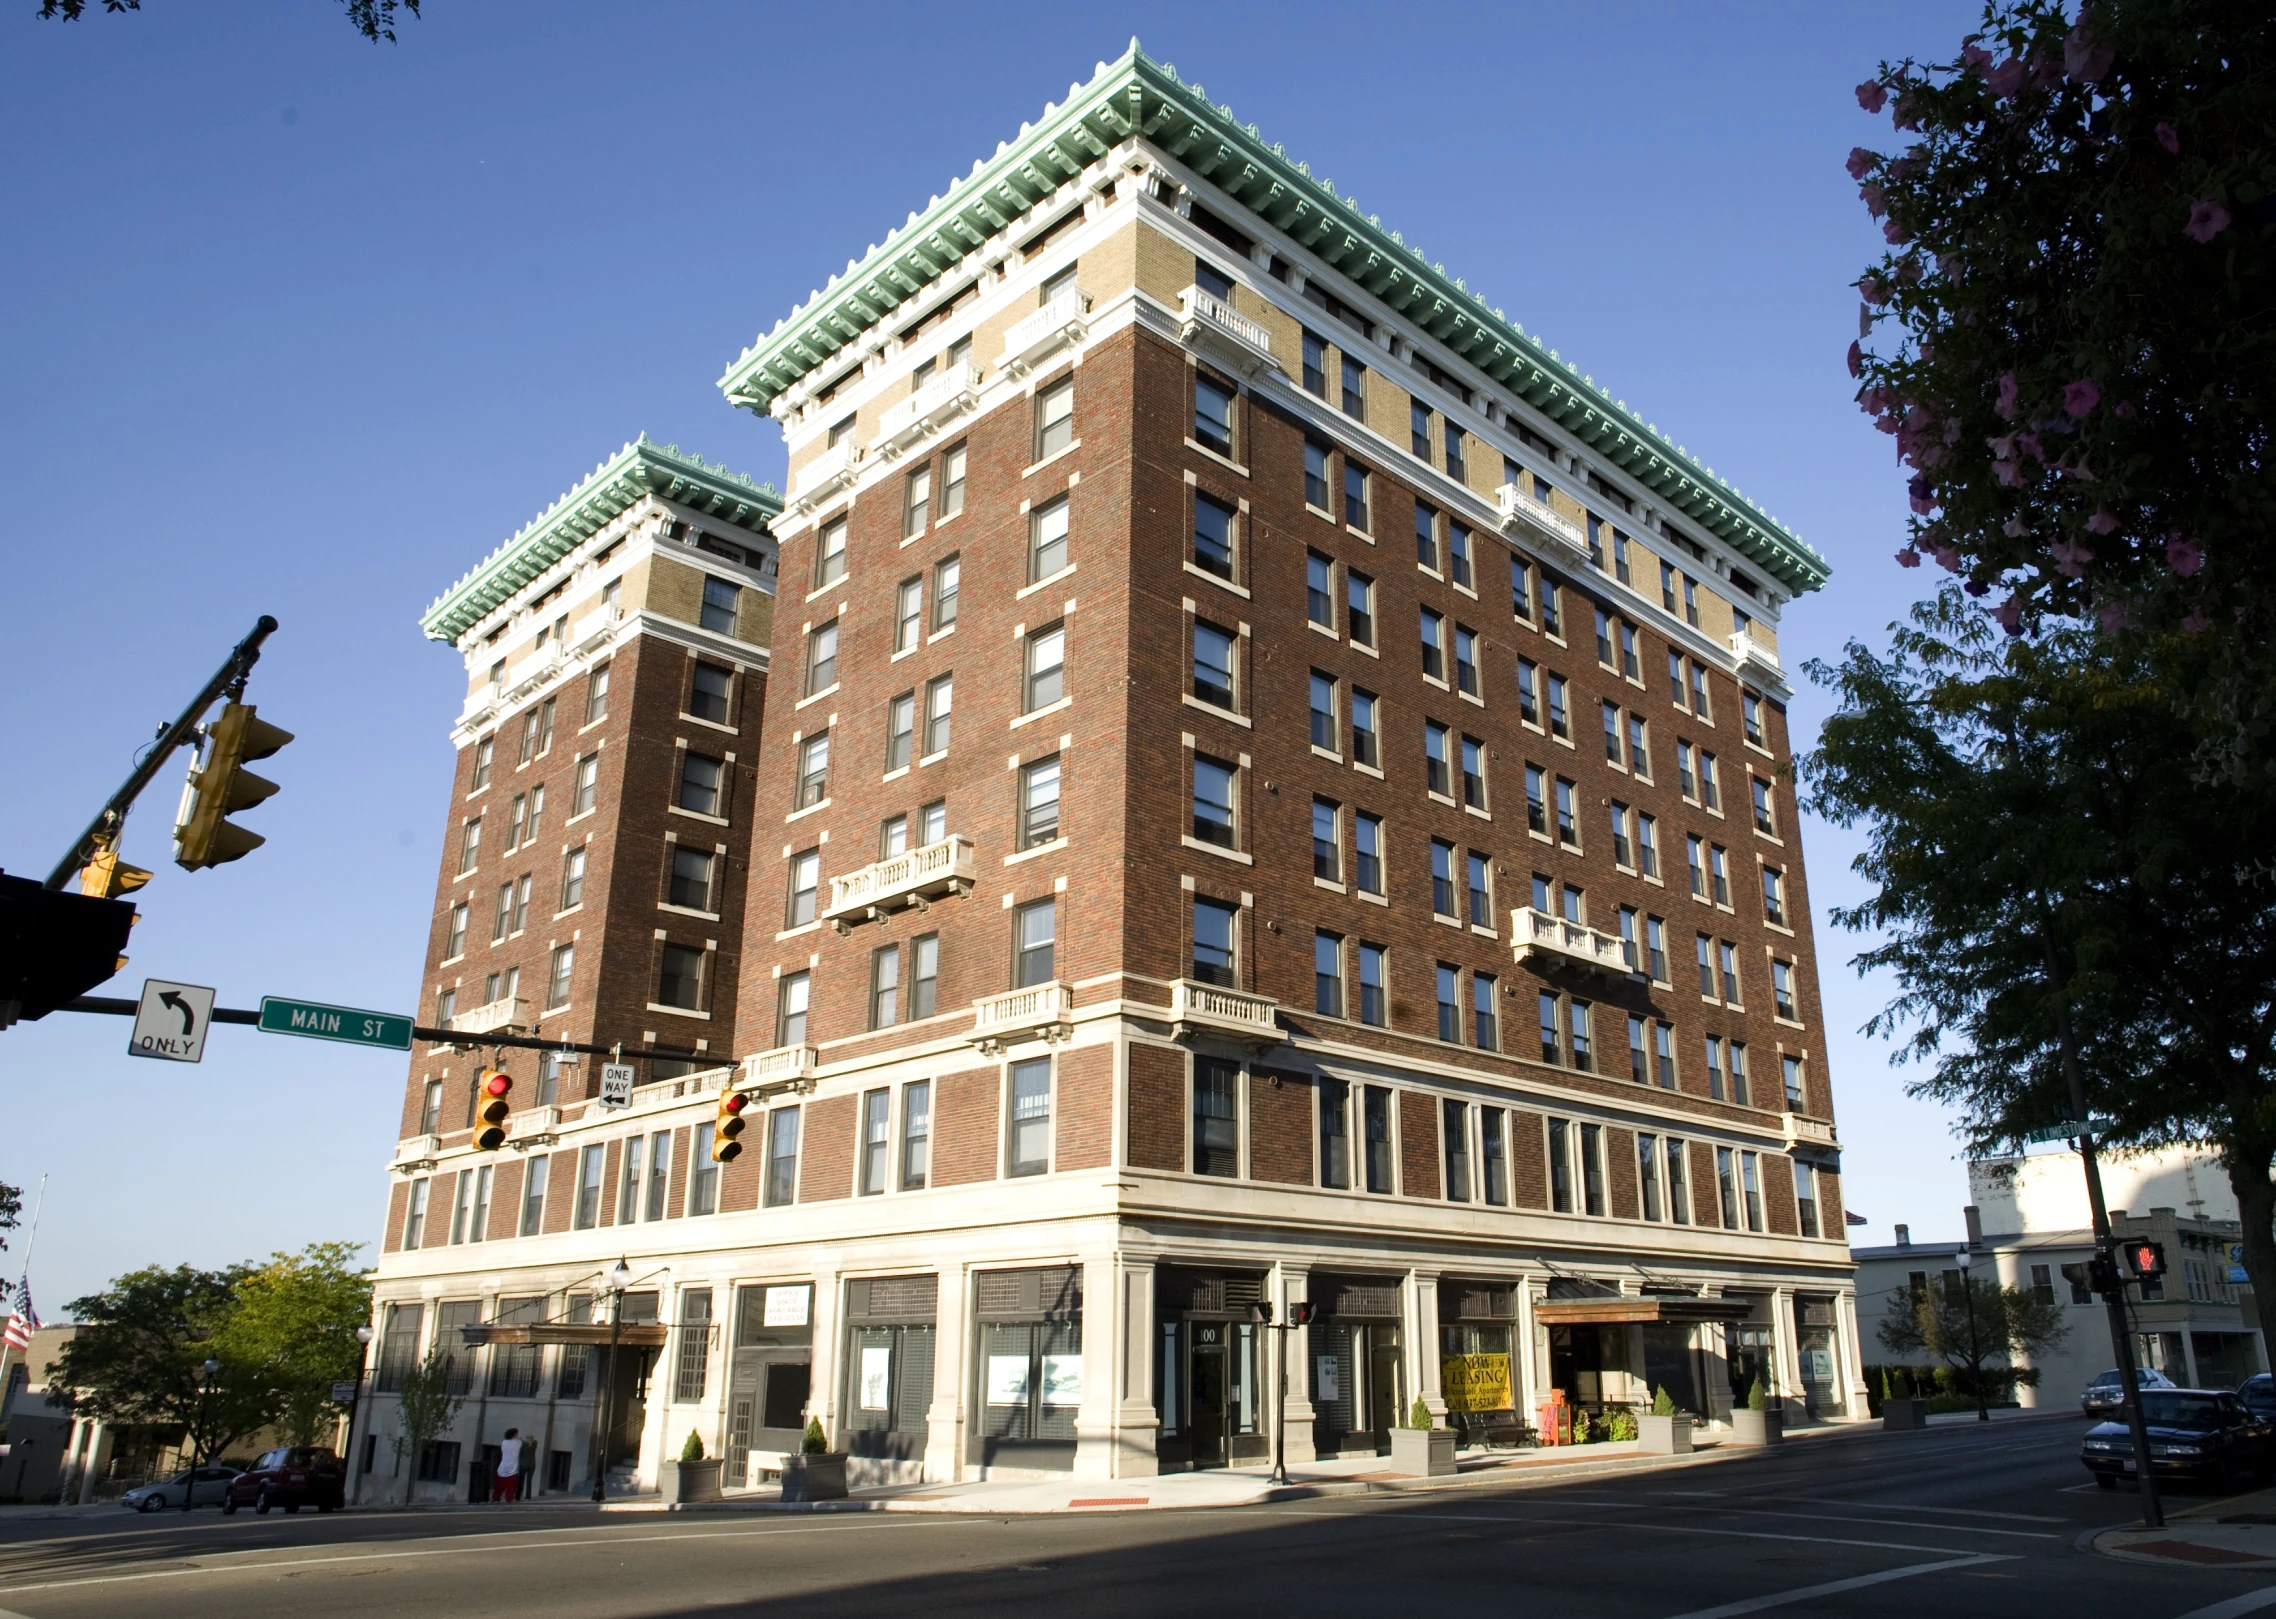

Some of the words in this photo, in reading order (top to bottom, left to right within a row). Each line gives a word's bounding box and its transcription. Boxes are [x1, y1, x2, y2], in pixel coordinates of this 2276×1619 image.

[291, 1009, 341, 1033] MAIN
[362, 1019, 386, 1039] ST
[141, 1036, 195, 1055] ONLY
[606, 1068, 630, 1081] ONE
[605, 1081, 629, 1093] WAY
[2043, 1121, 2093, 1140] LIMESTONE
[2097, 1120, 2107, 1130] ST
[775, 1289, 800, 1297] OFFICE
[1200, 1328, 1216, 1342] 100
[1463, 1355, 1490, 1370] NOW
[1451, 1369, 1503, 1385] LEASING
